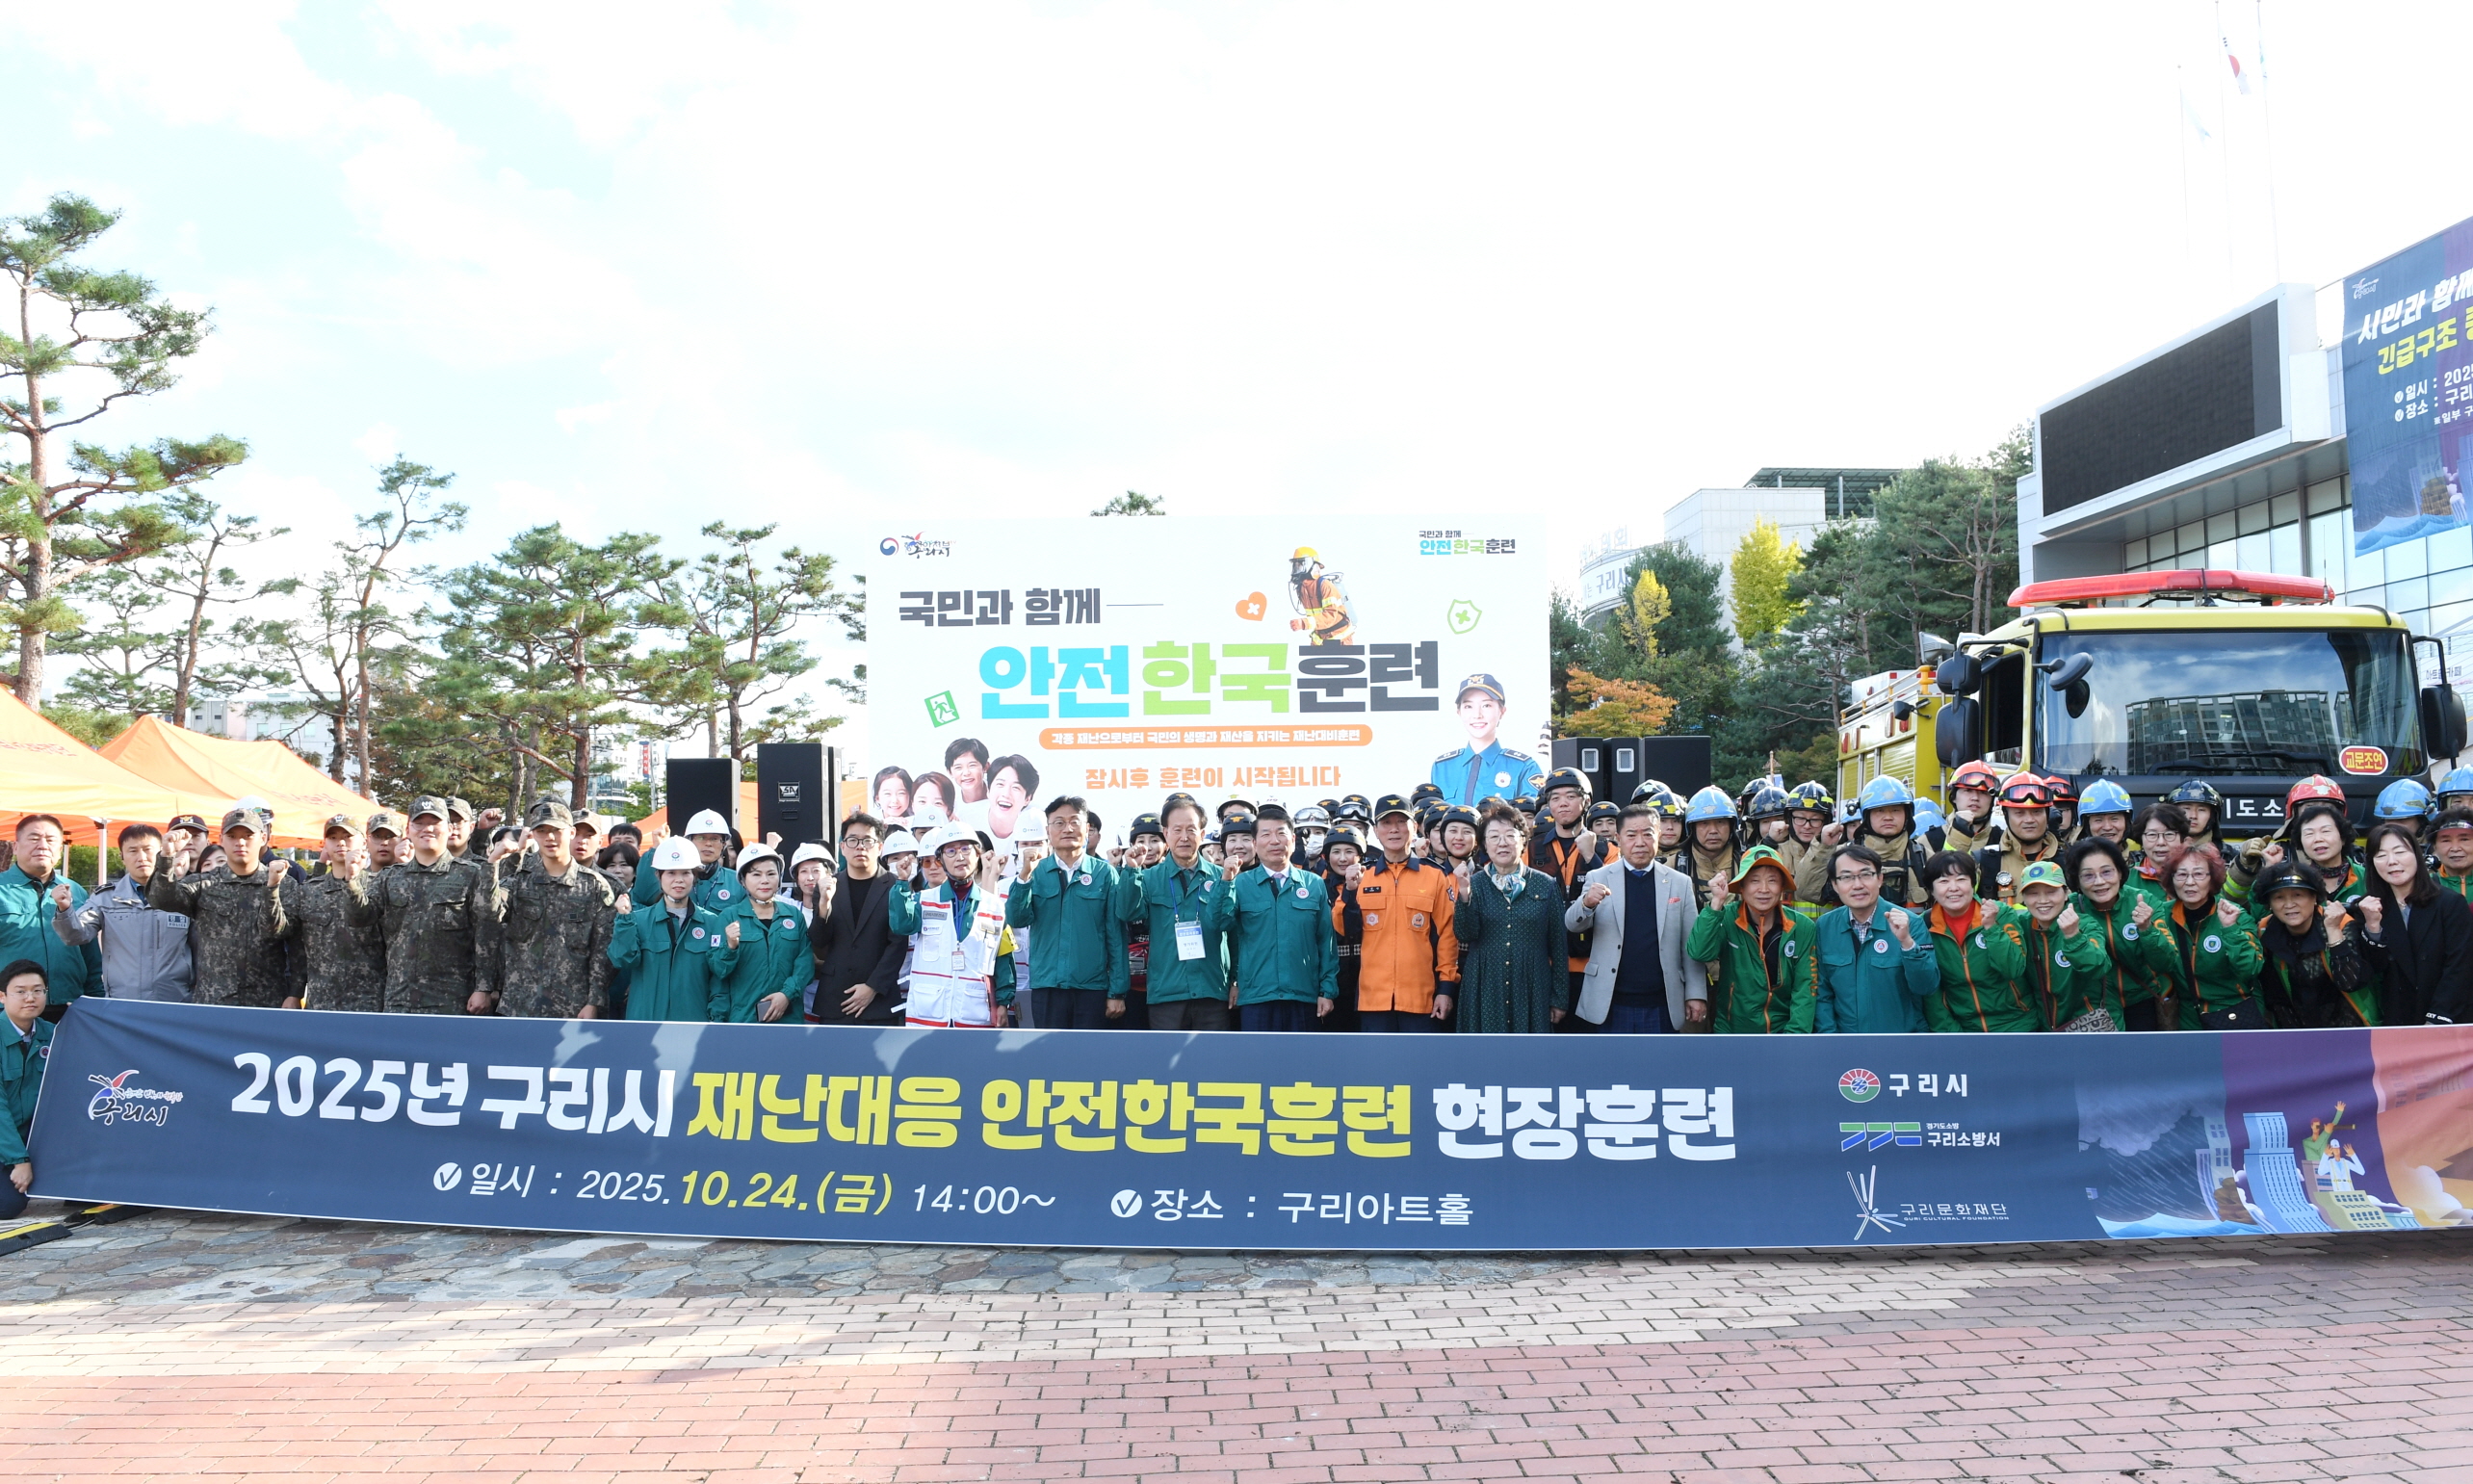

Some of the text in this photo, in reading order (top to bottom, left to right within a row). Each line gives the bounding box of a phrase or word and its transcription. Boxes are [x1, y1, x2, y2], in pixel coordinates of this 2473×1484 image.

[2358, 290, 2426, 345] 시민과
[2378, 317, 2458, 376] 긴급구조
[2406, 379, 2428, 402] 일시
[2406, 400, 2429, 420] 장소
[1419, 538, 1516, 556] 안전한국훈련
[899, 588, 1101, 627] 국민과 함께
[978, 639, 1441, 719] 안전한국훈련
[1052, 729, 1360, 744] 각종 재난으로부터 국민의 생명과 재산을 지키는 재난대비훈련
[2345, 750, 2383, 771] 교문조연
[1085, 765, 1341, 789] 잠시후 훈련이 시작됩니다
[1888, 1074, 1967, 1097] 구리시
[92, 1097, 169, 1127] 구리시
[231, 1053, 1735, 1160] 2025년 구리시 재난대응 안전한국훈련 현장훈련
[1927, 1133, 2000, 1147] 구리소방서
[469, 1162, 536, 1199] 일시
[553, 1171, 562, 1199] :
[1151, 1187, 1473, 1228] 장소 : 구리아트홀
[1900, 1204, 2007, 1216] 구리문화재단
